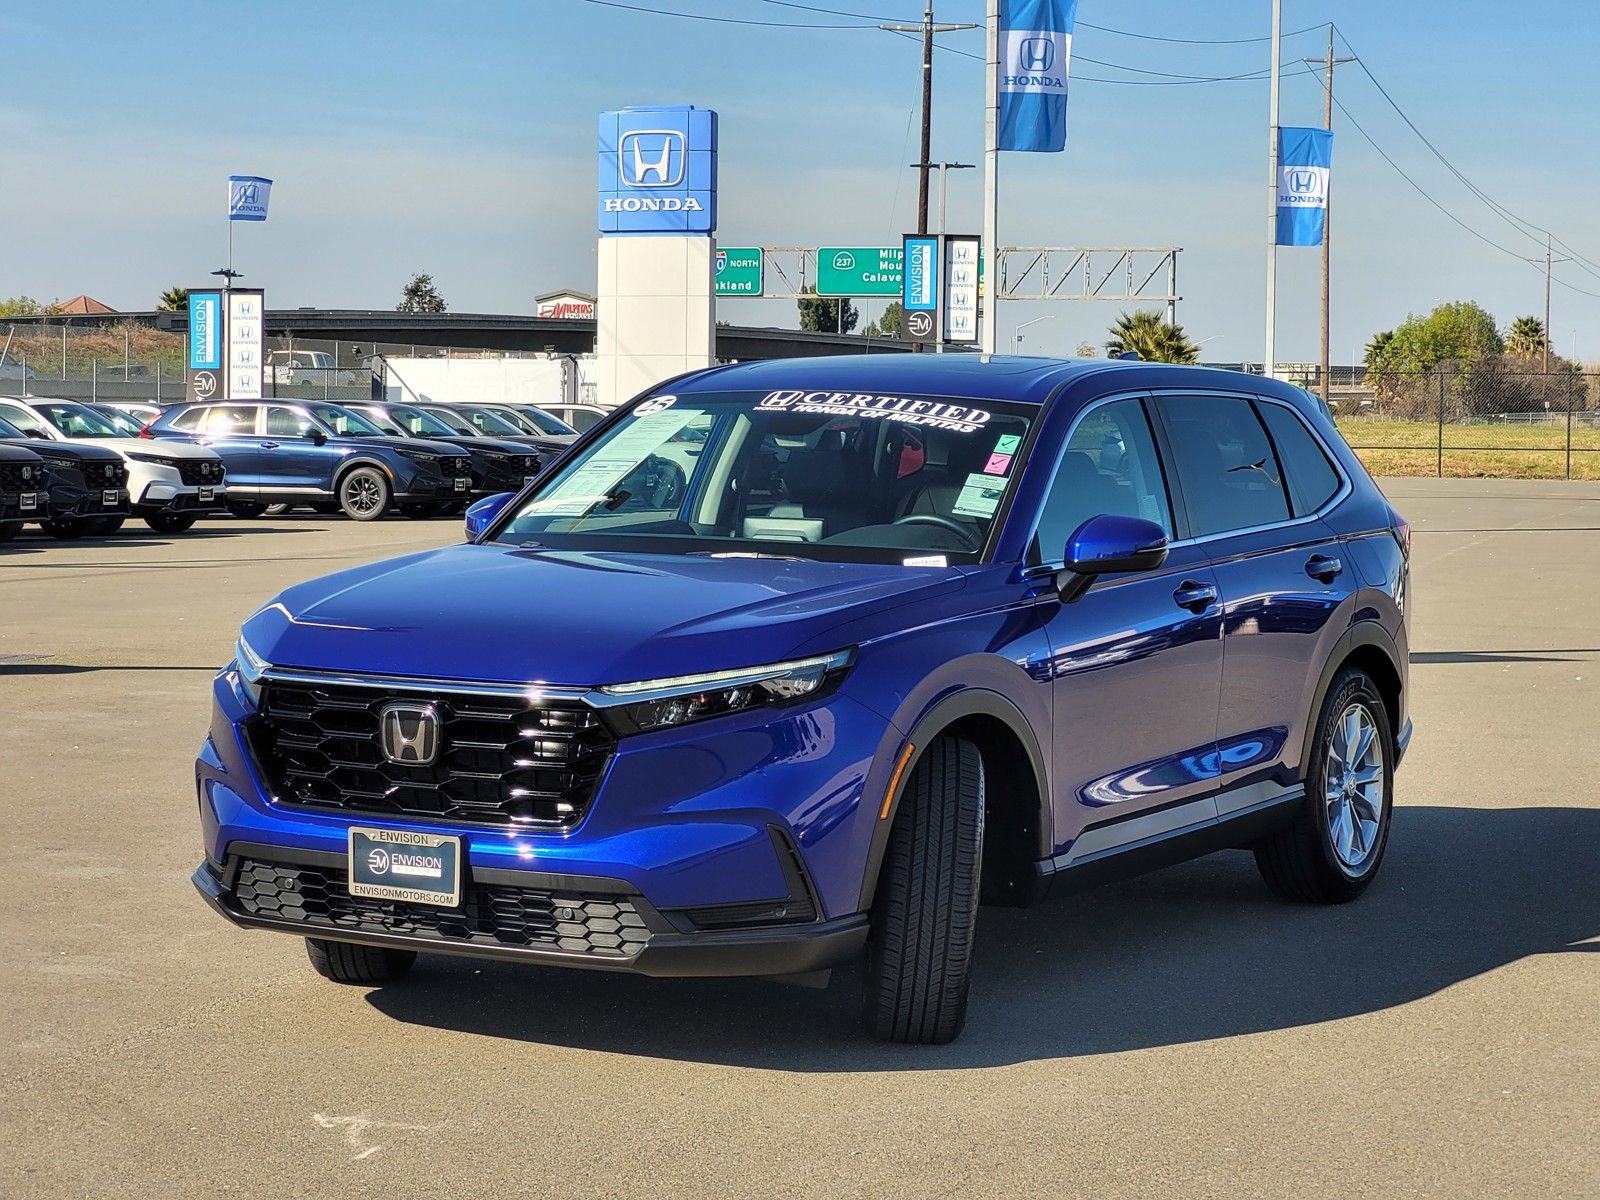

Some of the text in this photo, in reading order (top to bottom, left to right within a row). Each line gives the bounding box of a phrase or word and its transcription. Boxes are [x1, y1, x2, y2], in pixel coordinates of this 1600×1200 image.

[1003, 76, 1064, 88] HONDA
[604, 197, 704, 212] HONDA
[1280, 195, 1325, 204] HONDA
[730, 259, 759, 268] NORTH
[836, 258, 851, 267] 237
[879, 261, 902, 270] Mou
[862, 272, 902, 282] Calave
[910, 245, 922, 304] ENVISION
[195, 300, 206, 363] ENVISION
[803, 391, 991, 424] CERTIFIED
[791, 404, 977, 433] HONDA OF MILPITAS
[379, 831, 429, 845] ENVISION
[391, 853, 442, 868] ENVISION
[354, 885, 454, 905] ENVISIONMOTORS.COM
